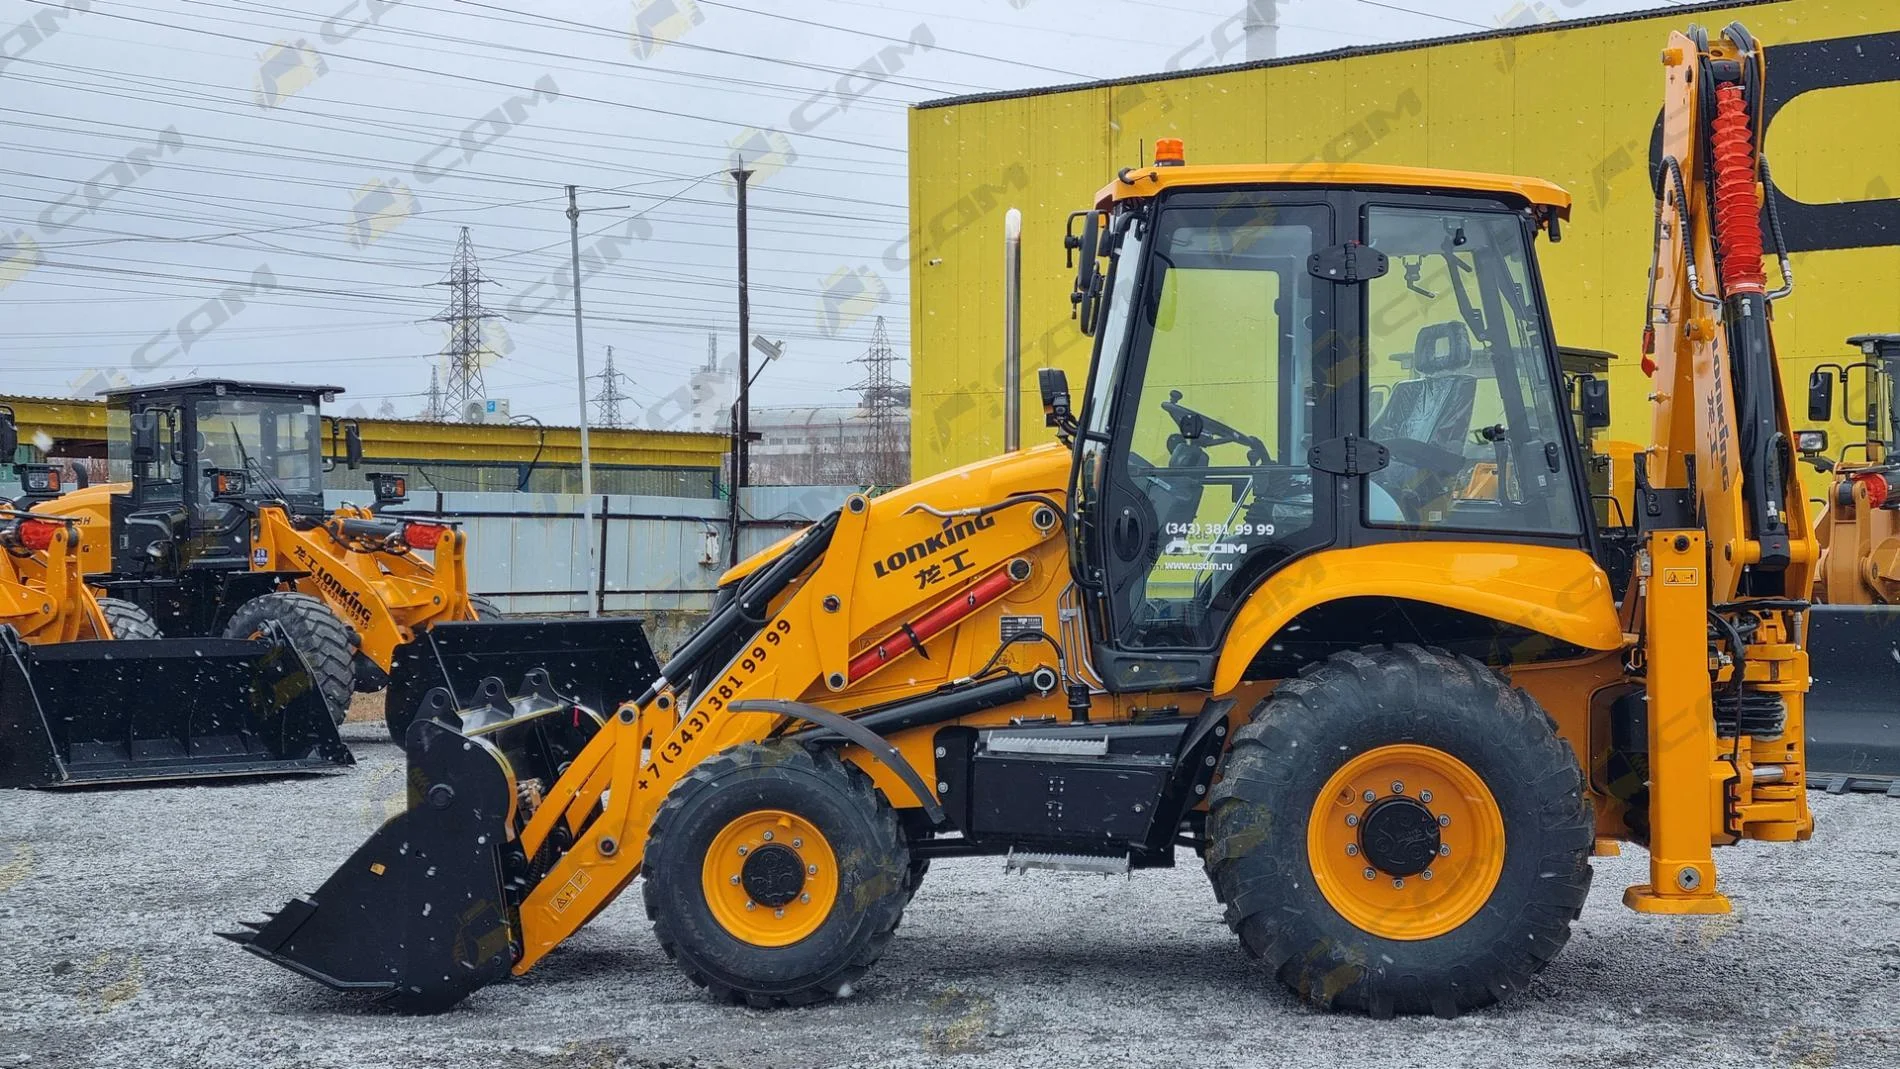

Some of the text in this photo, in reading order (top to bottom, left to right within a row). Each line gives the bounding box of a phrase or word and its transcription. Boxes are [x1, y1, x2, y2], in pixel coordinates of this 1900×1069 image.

[1165, 522, 1275, 536] (343) 381 99 99
[1165, 562, 1233, 571] www.usdm.ru
[660, 710, 711, 764] (343)
[708, 675, 744, 712] 381
[741, 647, 767, 674] 99
[766, 619, 792, 646] 99
